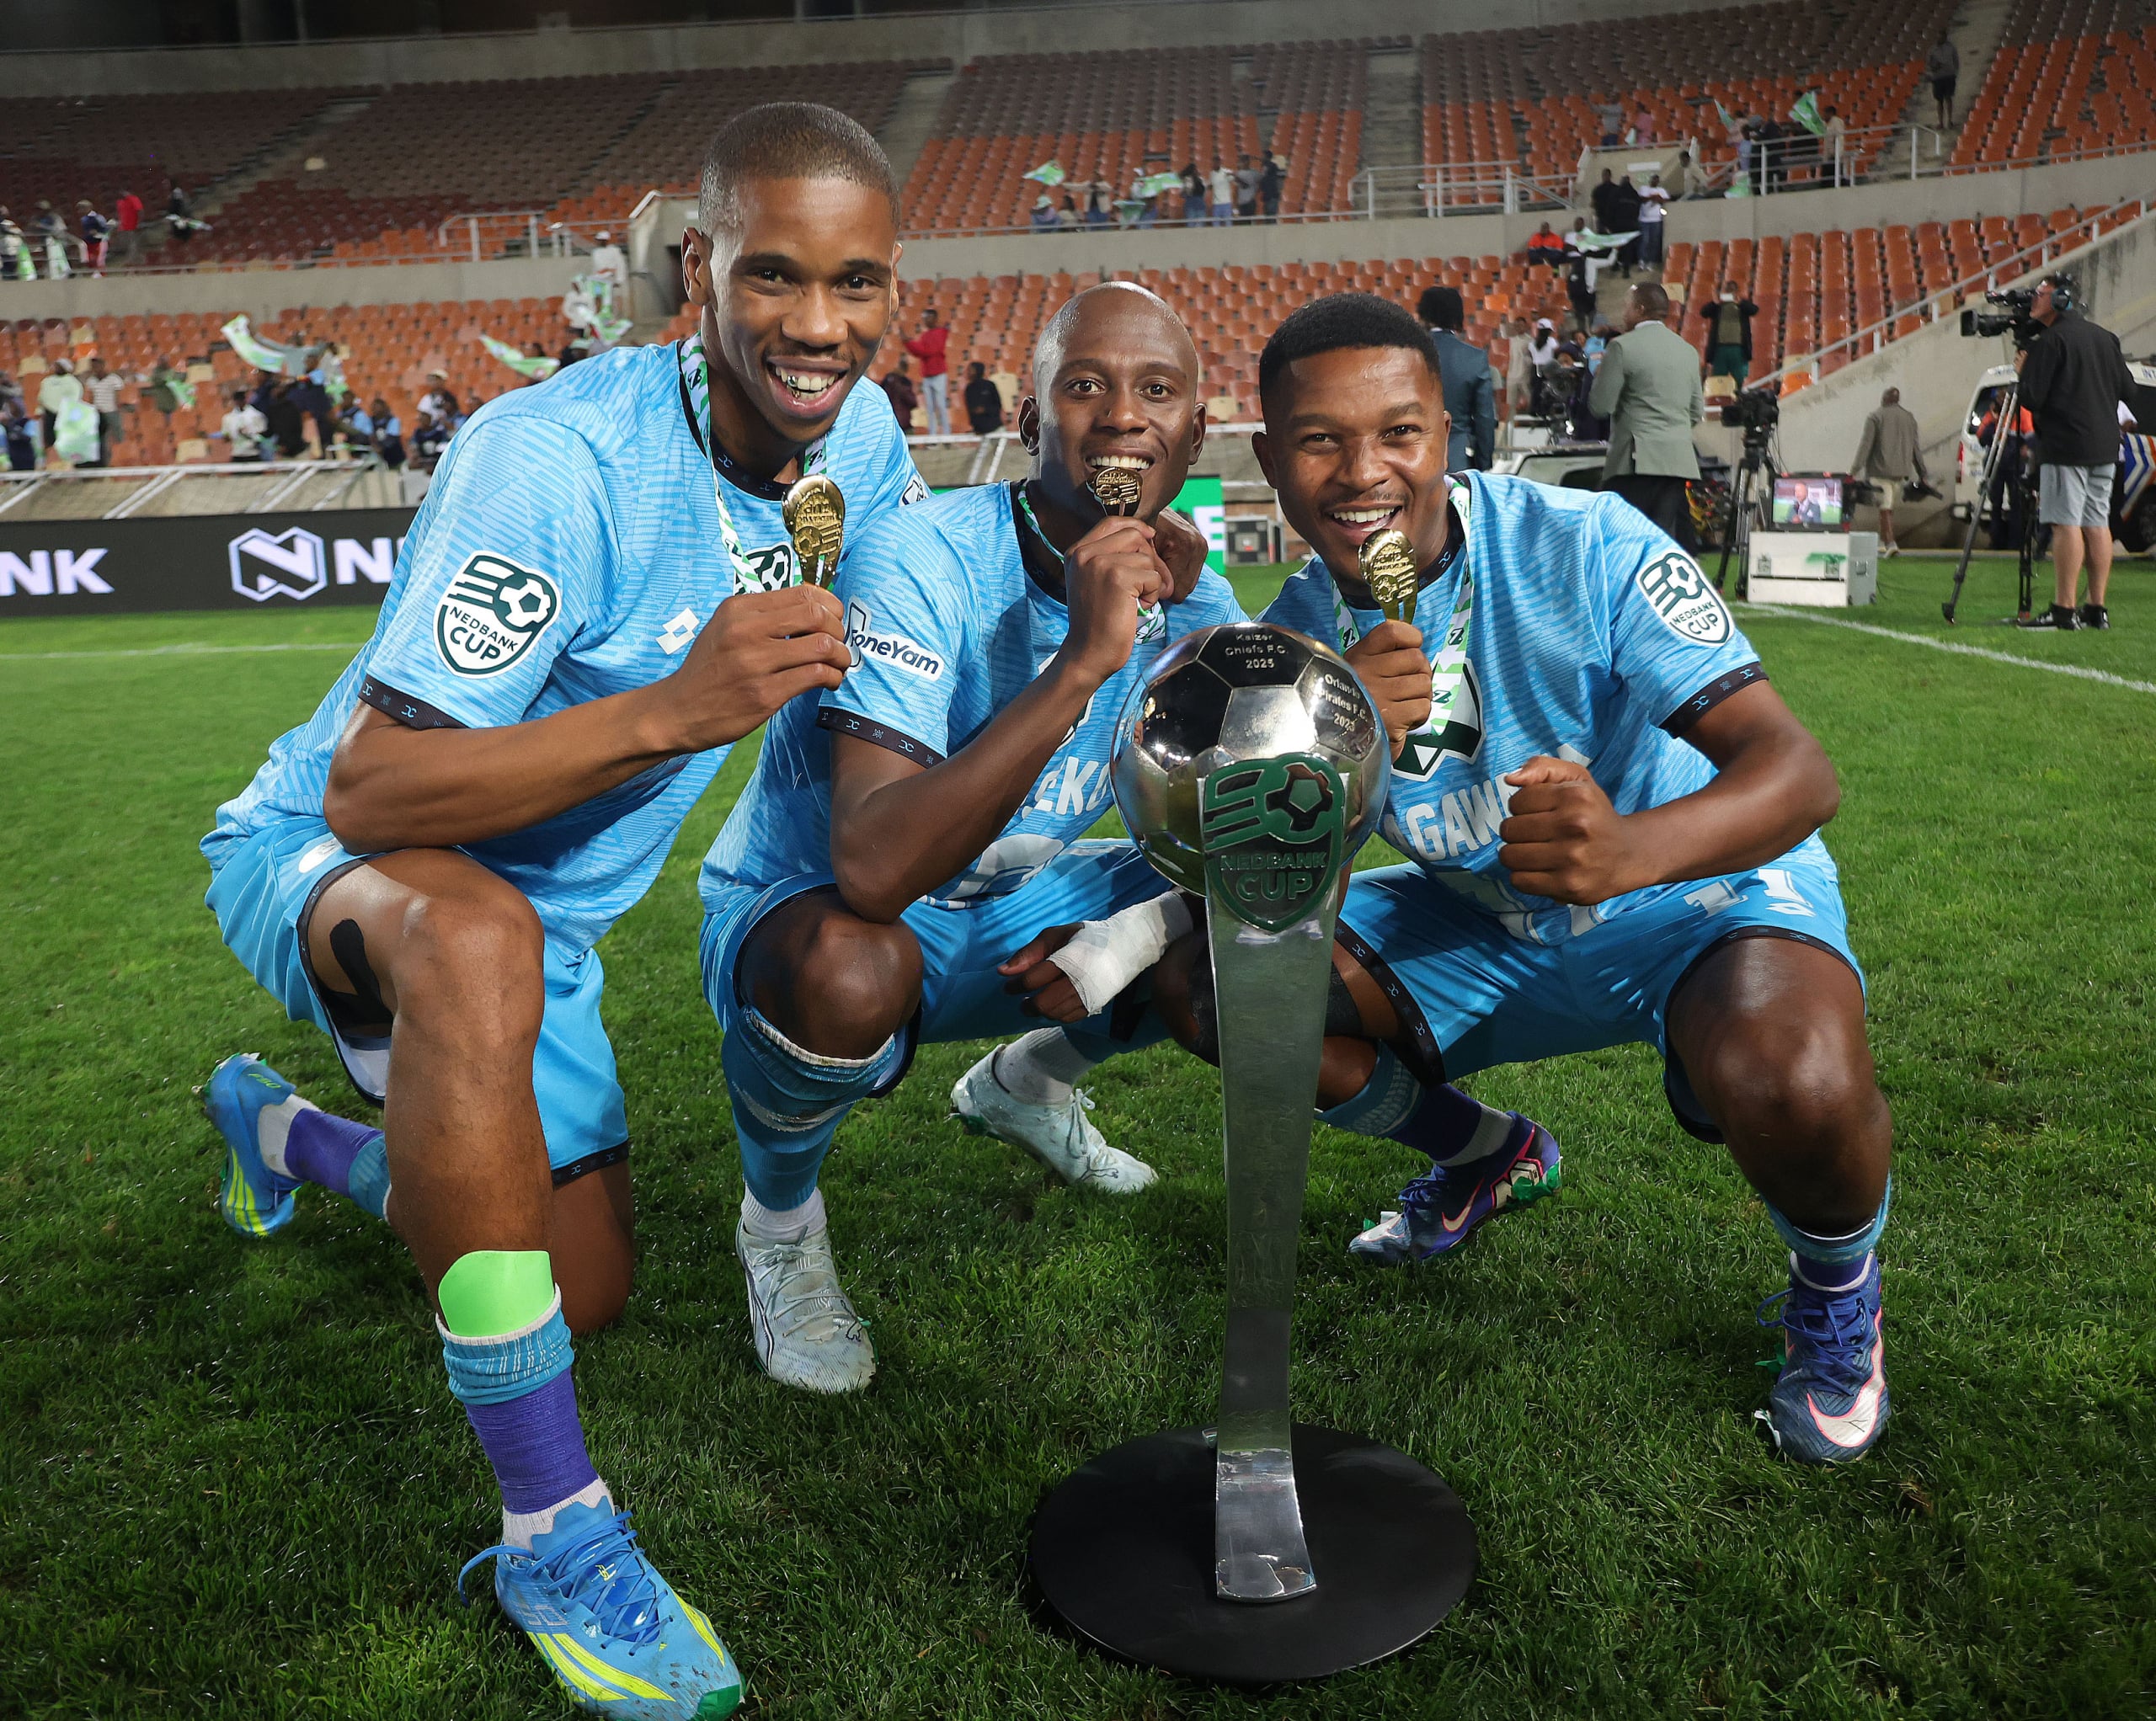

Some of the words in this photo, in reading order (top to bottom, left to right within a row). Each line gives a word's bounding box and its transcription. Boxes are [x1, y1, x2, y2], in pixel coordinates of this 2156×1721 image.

[1672, 601, 1716, 625] NEDBANK
[1688, 613, 1718, 635] CUP
[450, 606, 518, 652] NEDBANK
[450, 626, 501, 660] CUP
[1225, 644, 1263, 656] Chiefs
[1246, 658, 1275, 669] 2025
[1325, 674, 1361, 699] Orlando
[1317, 689, 1352, 711] Pirates
[1220, 851, 1327, 871] NEDBANK
[1235, 871, 1313, 902] CUP
